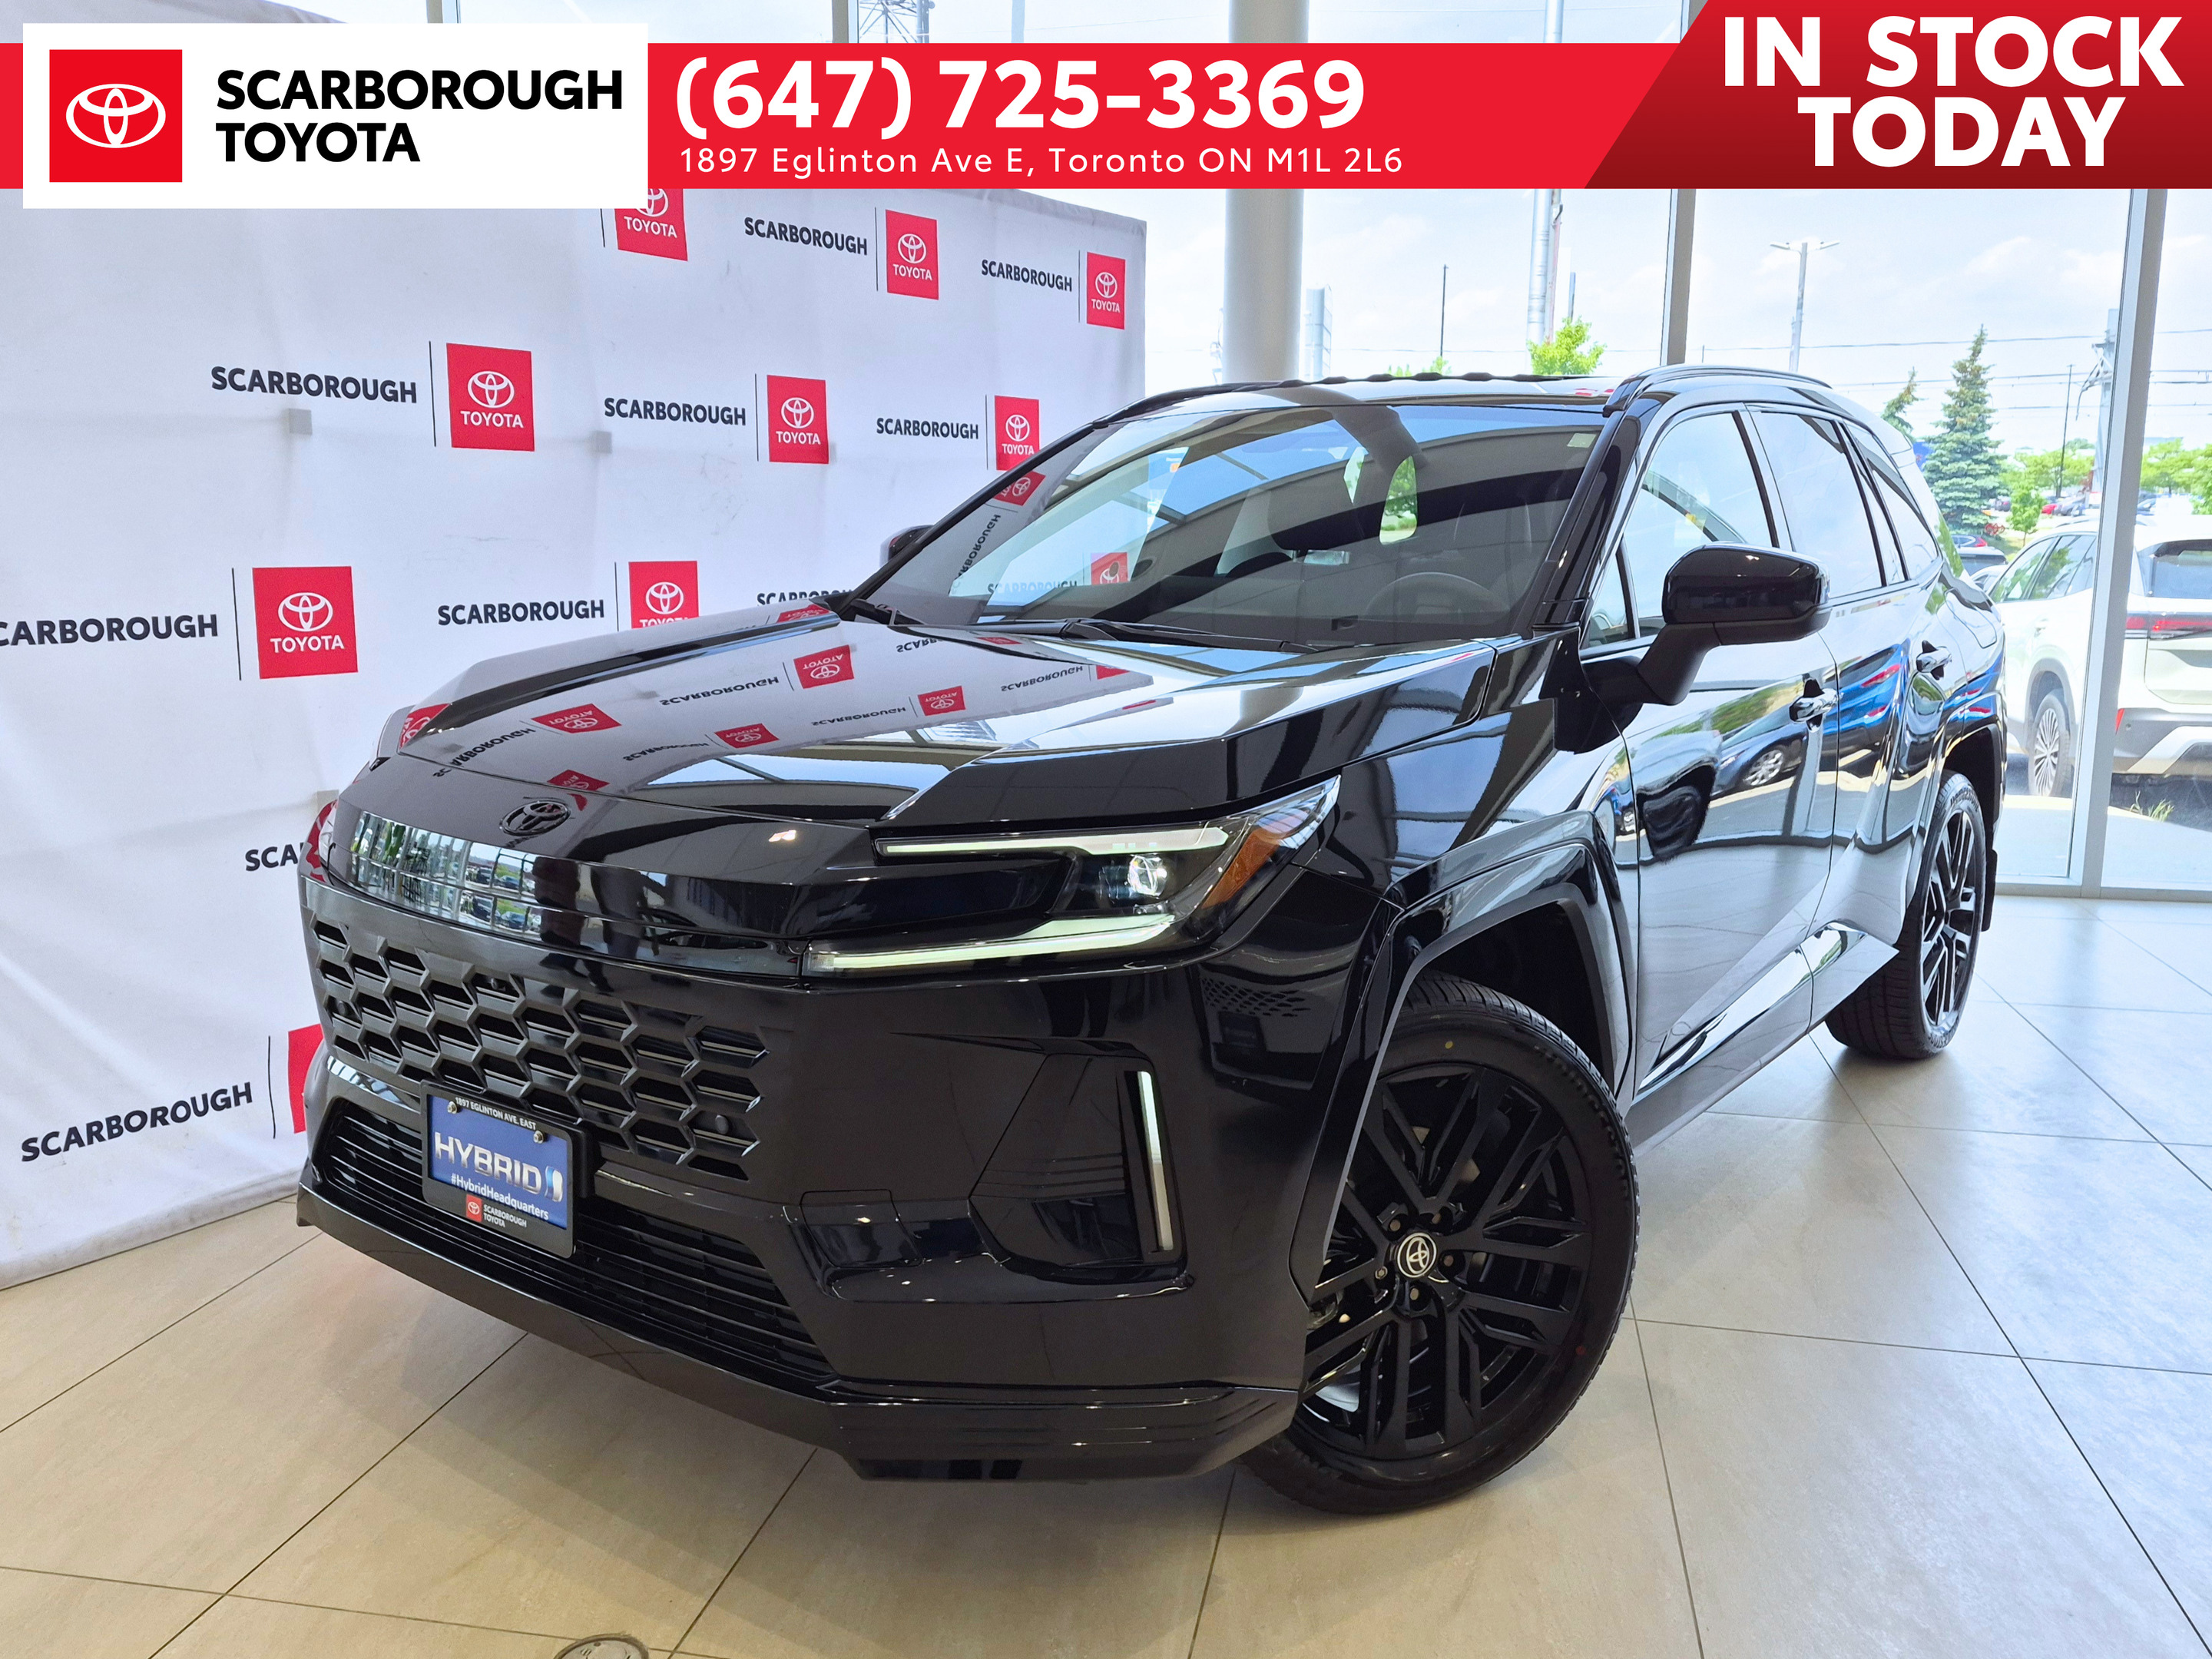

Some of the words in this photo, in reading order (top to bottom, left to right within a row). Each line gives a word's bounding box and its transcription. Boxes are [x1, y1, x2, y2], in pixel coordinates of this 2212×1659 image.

[624, 216, 677, 239] TOYOTA
[744, 217, 867, 256] SCARBOROUGH
[892, 264, 932, 281] TOYOTA
[981, 259, 1072, 292] SCARBOROUGH
[1091, 299, 1121, 314] TOYOTA
[211, 366, 417, 404] SCARBOROUGH
[460, 410, 524, 429] TOYOTA
[604, 397, 746, 426] SCARBOROUGH
[776, 430, 821, 445] TOYOTA
[876, 417, 979, 439] SCARBOROUGH
[1002, 443, 1035, 455] TOYOTA
[438, 600, 604, 626] SCARBOROUGH
[270, 634, 345, 654] TOYOTA
[21, 1081, 253, 1162] SCARBOROUGH
[455, 1097, 469, 1108] 1897
[471, 1102, 503, 1119] EGLINTON
[519, 1118, 536, 1130] EAST
[434, 1131, 542, 1195] HYBRID
[450, 1173, 549, 1220] #HybridHeadquarters
[483, 1204, 527, 1227] SCARBOROUGH
[483, 1212, 505, 1227] TOYOTA
